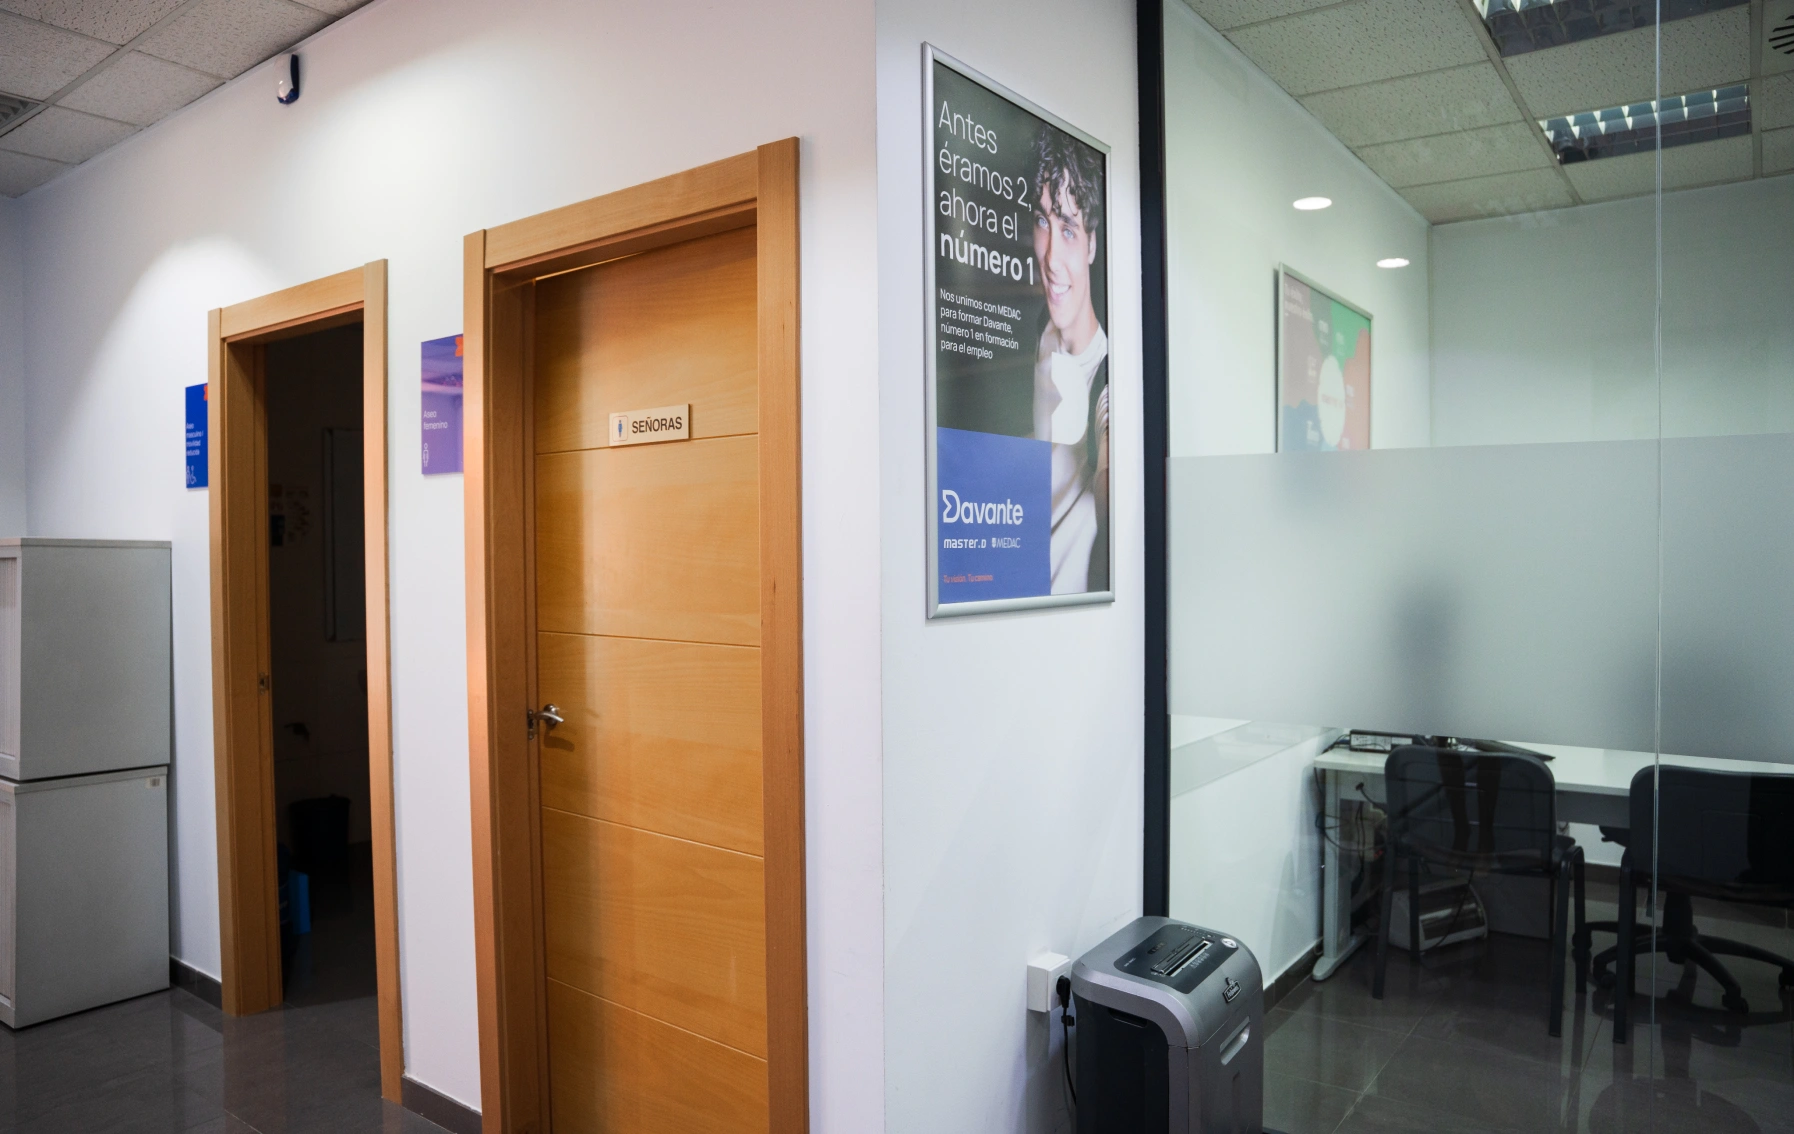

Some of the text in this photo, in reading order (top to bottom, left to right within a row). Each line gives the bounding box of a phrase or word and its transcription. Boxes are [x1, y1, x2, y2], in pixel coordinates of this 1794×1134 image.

[939, 100, 998, 154] Antes
[940, 140, 1032, 212] éramos 2,
[940, 187, 1018, 242] ahora el
[941, 229, 1034, 286] número 1
[940, 287, 1022, 321] Nos unimos con MEDAC
[940, 306, 1013, 335] para formar Davante,
[940, 321, 1019, 350] número 1 en formación
[940, 339, 994, 360] para el empleo
[423, 410, 437, 419] Aseo
[631, 416, 683, 434] SEÑORAS
[942, 489, 1024, 526] Davante
[996, 537, 1021, 549] MEDAC
